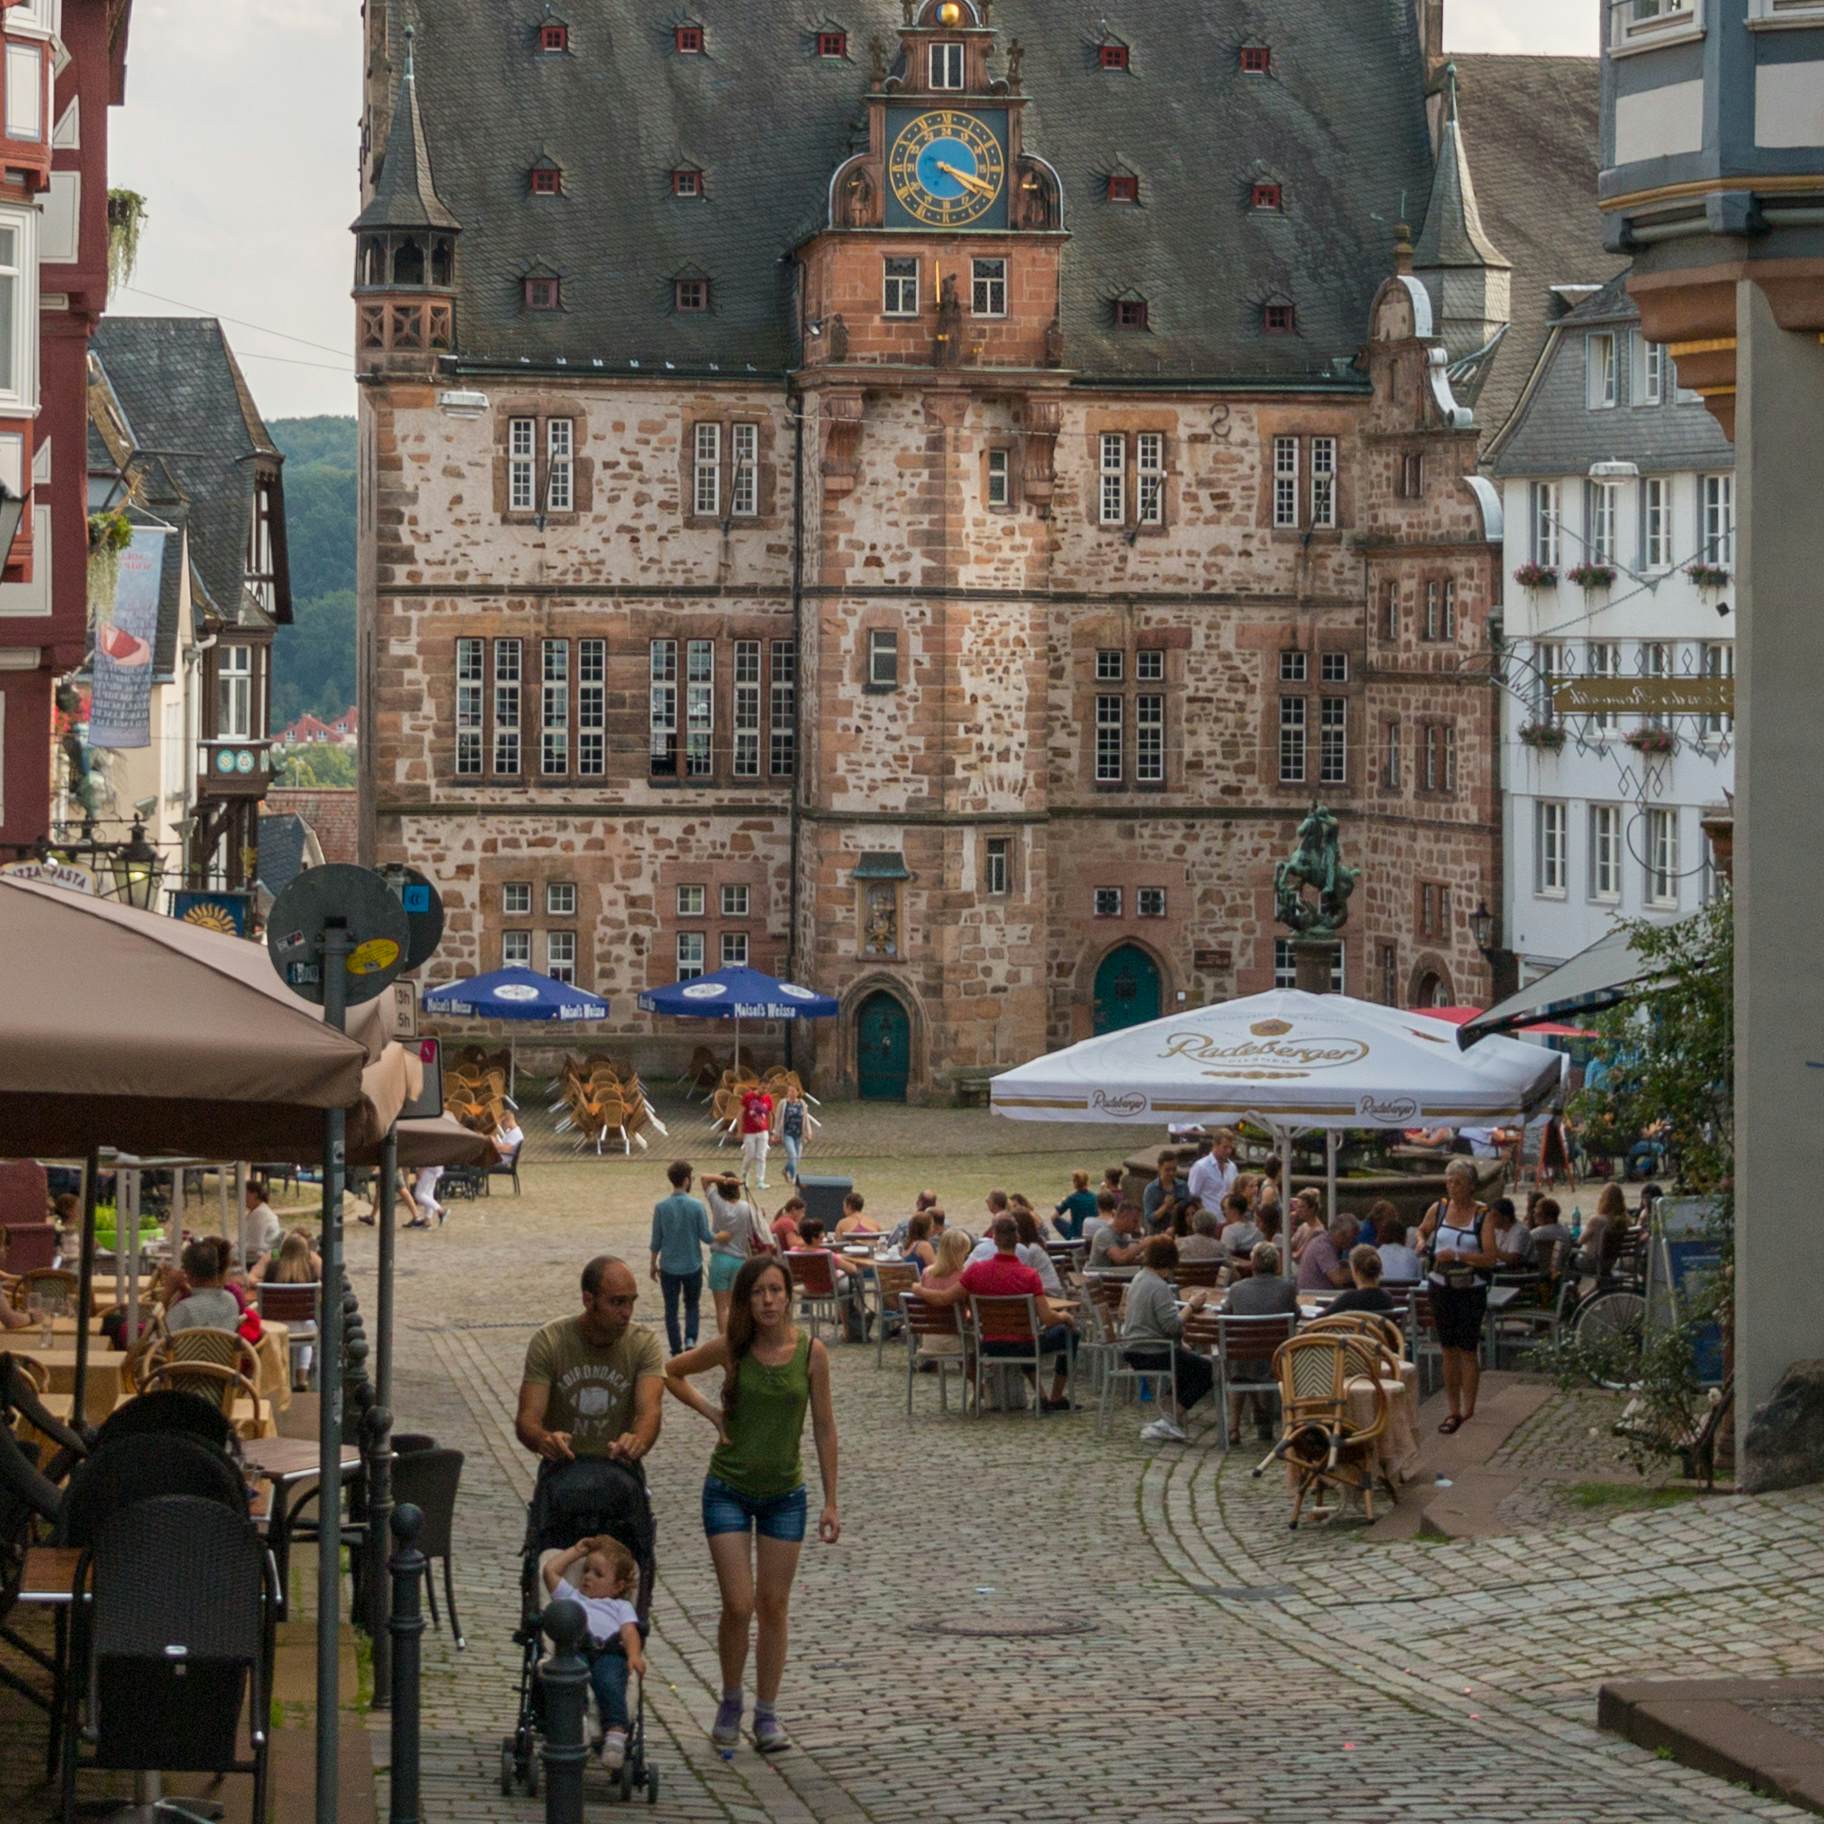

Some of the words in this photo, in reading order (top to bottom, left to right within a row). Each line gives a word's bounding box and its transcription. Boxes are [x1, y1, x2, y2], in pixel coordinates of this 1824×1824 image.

[51, 865, 87, 889] PASTA
[734, 1002, 766, 1018] Maisel's
[767, 1002, 796, 1018] Weisse
[1157, 1032, 1369, 1068] Radeberger
[1360, 1095, 1416, 1121] Radeberger
[557, 1364, 632, 1393] ADIRONDACK
